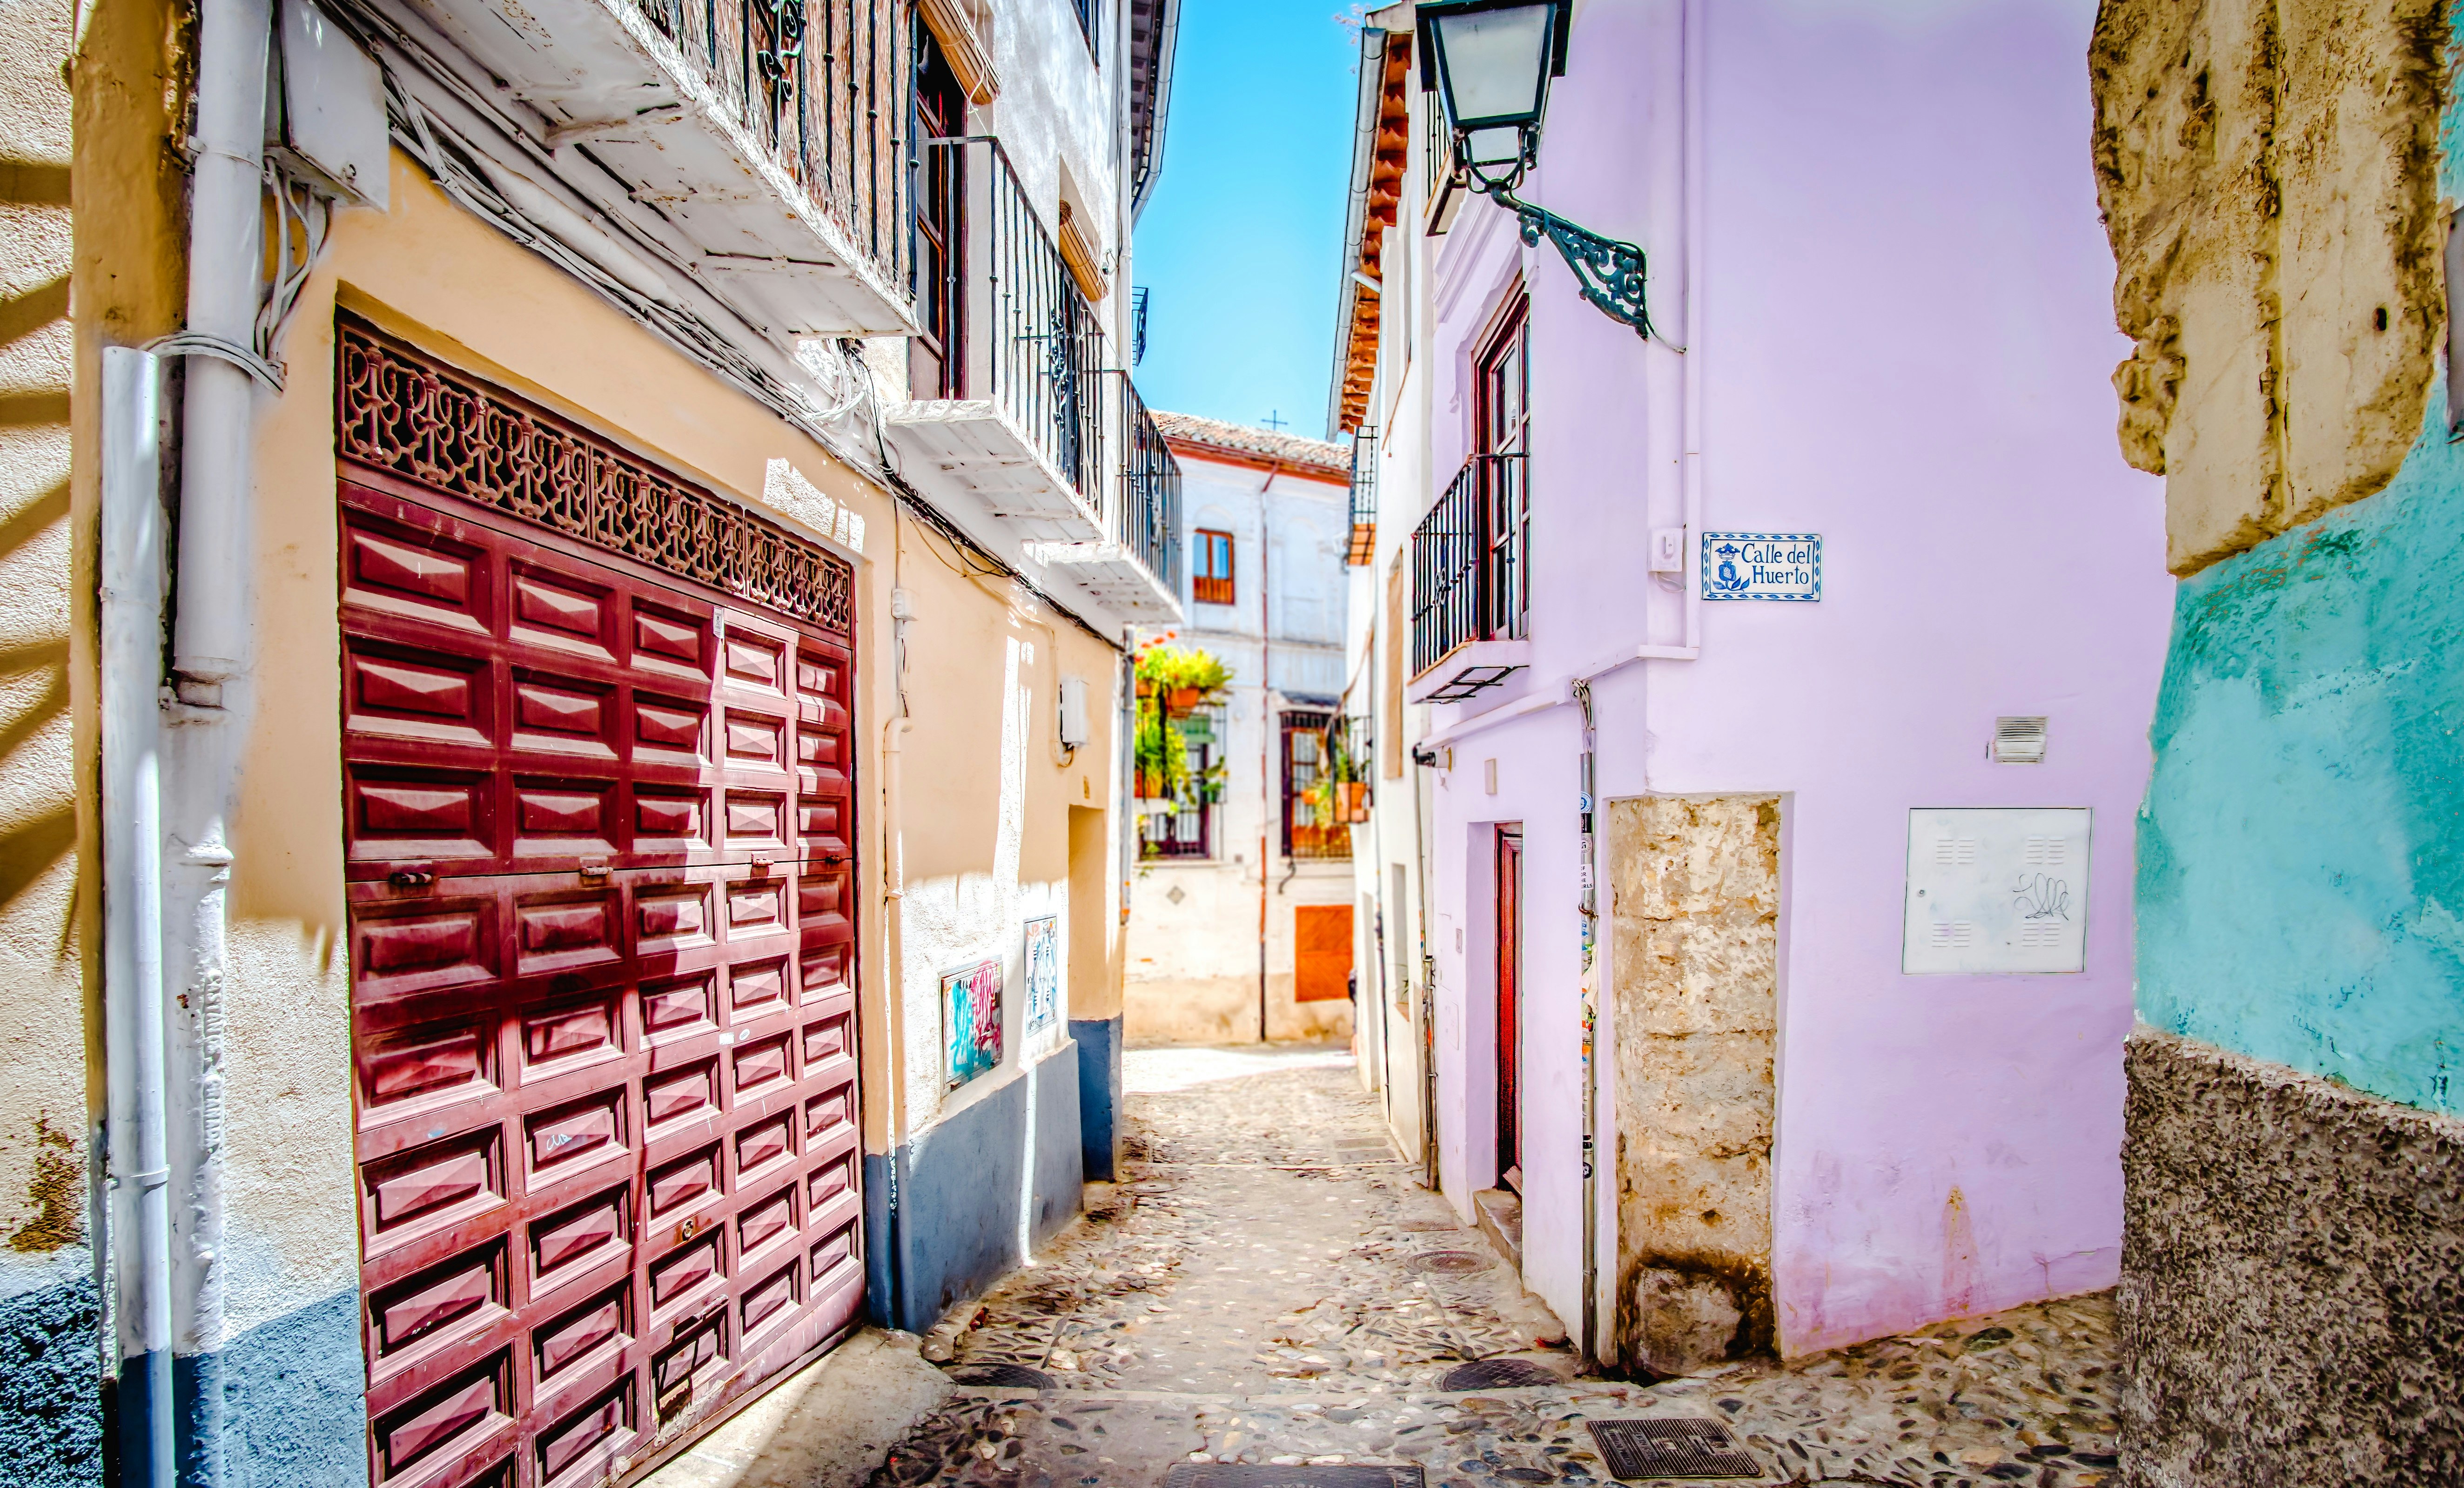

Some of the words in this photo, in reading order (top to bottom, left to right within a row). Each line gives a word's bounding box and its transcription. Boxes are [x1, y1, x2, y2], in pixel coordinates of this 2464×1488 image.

[1741, 543, 1782, 564] Calle
[1787, 544, 1811, 564] del
[1752, 565, 1809, 584] Huerto
